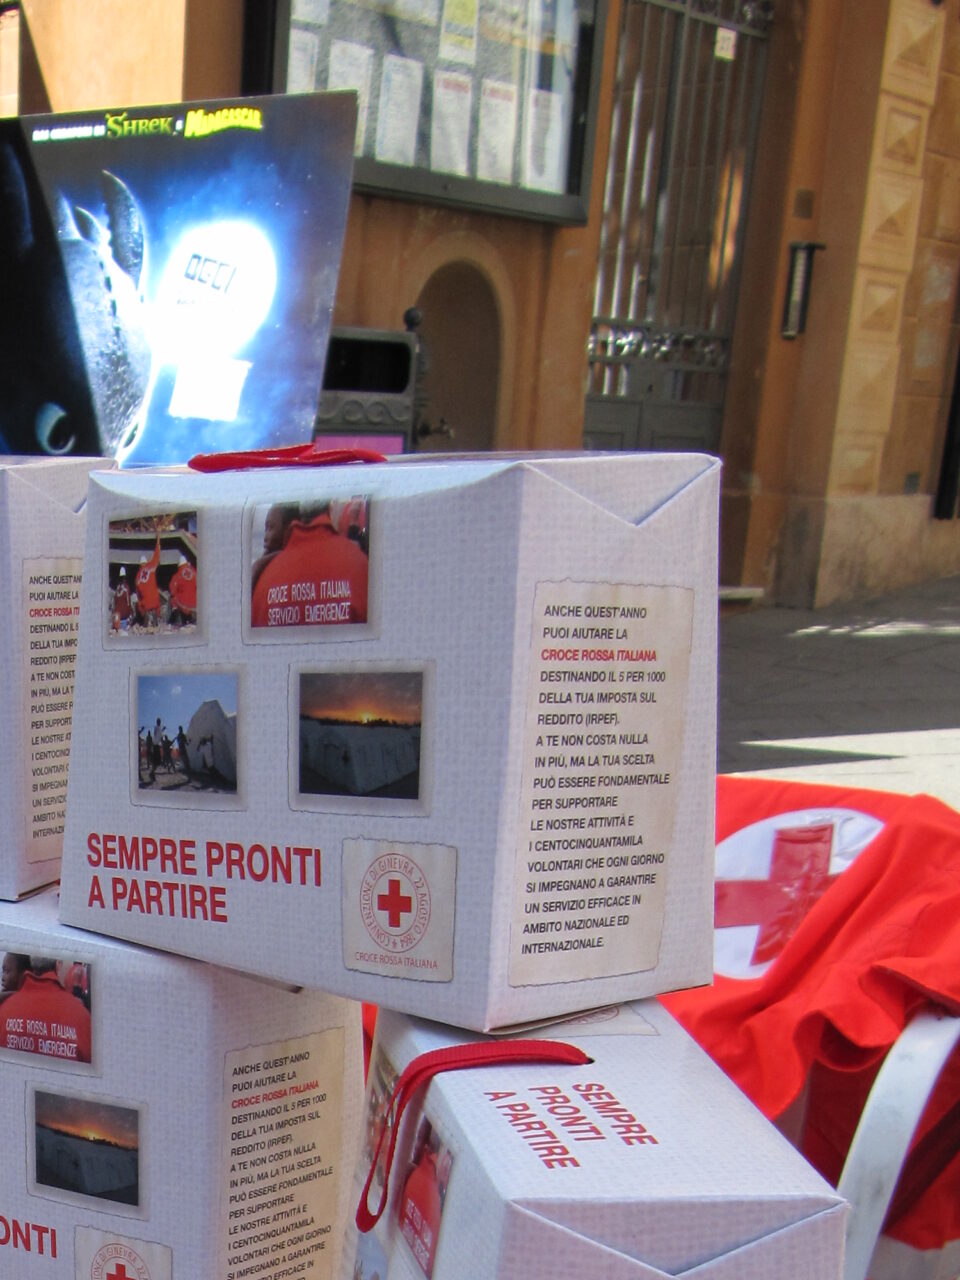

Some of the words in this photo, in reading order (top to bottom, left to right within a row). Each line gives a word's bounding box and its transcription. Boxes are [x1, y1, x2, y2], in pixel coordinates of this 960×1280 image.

[268, 585, 289, 605] CROCE
[292, 582, 316, 602] ROSSA
[320, 579, 352, 600] ITALIANA
[268, 606, 300, 627] SERVIZIO
[305, 602, 351, 623] EMERGENZE
[544, 605, 582, 617] ANCHE
[584, 606, 647, 619] QUEST'ANNO
[543, 627, 569, 639] PUOI
[572, 628, 614, 639] AIUTARE
[616, 629, 627, 639] LA
[541, 649, 579, 661] CROCE
[581, 649, 615, 661] ROSSA
[617, 650, 656, 661] ITALIANA
[540, 671, 606, 682] DESTINANDO
[608, 672, 616, 682] IL
[619, 671, 624, 682] 5
[626, 671, 644, 682] PER
[647, 671, 666, 682] 1000
[539, 692, 572, 704] DELLA
[575, 692, 594, 704] TUA
[597, 692, 637, 703] IMPOSTA
[640, 692, 657, 703] SUL
[537, 714, 583, 725] REDDITO
[585, 713, 619, 726] (IRPEF).
[536, 736, 543, 746] A
[546, 735, 559, 746] TE
[561, 735, 584, 746] NON
[586, 734, 617, 746] COSTA
[619, 734, 648, 745] NULLA
[88, 833, 196, 874] SEMPRE
[207, 842, 320, 885] PRONTI
[89, 875, 104, 908] A
[112, 877, 227, 922] PARTIRE
[484, 1090, 517, 1102] A
[528, 1087, 605, 1141] PRONTI
[572, 1083, 659, 1147] SEMPRE
[496, 1104, 580, 1169] PARTIRE
